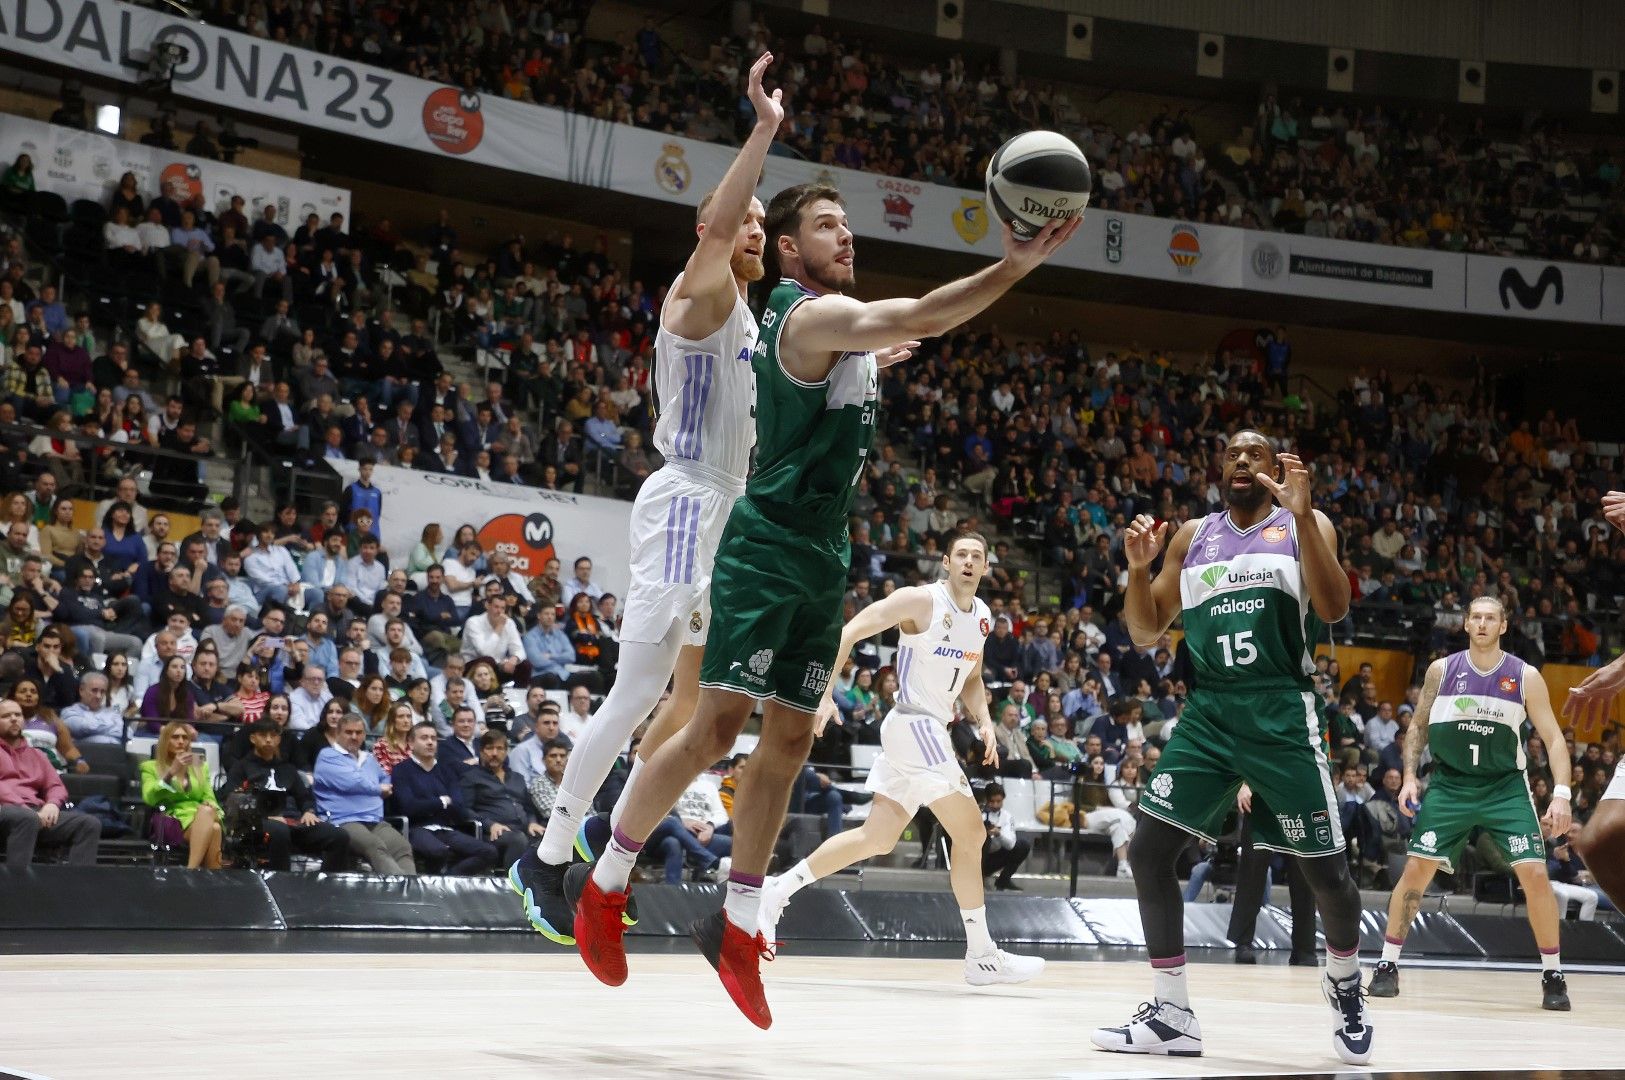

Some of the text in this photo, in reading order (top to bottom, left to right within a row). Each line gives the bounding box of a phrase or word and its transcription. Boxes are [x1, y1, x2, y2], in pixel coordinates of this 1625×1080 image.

[0, 0, 394, 130] DALONA'23
[1298, 260, 1424, 284] Ajuntament de Badalona
[1228, 567, 1274, 584] Unicaja
[1216, 630, 1258, 667] 15
[948, 667, 960, 692] 1
[1477, 707, 1504, 718] Unicaja
[1469, 744, 1480, 766] 1
